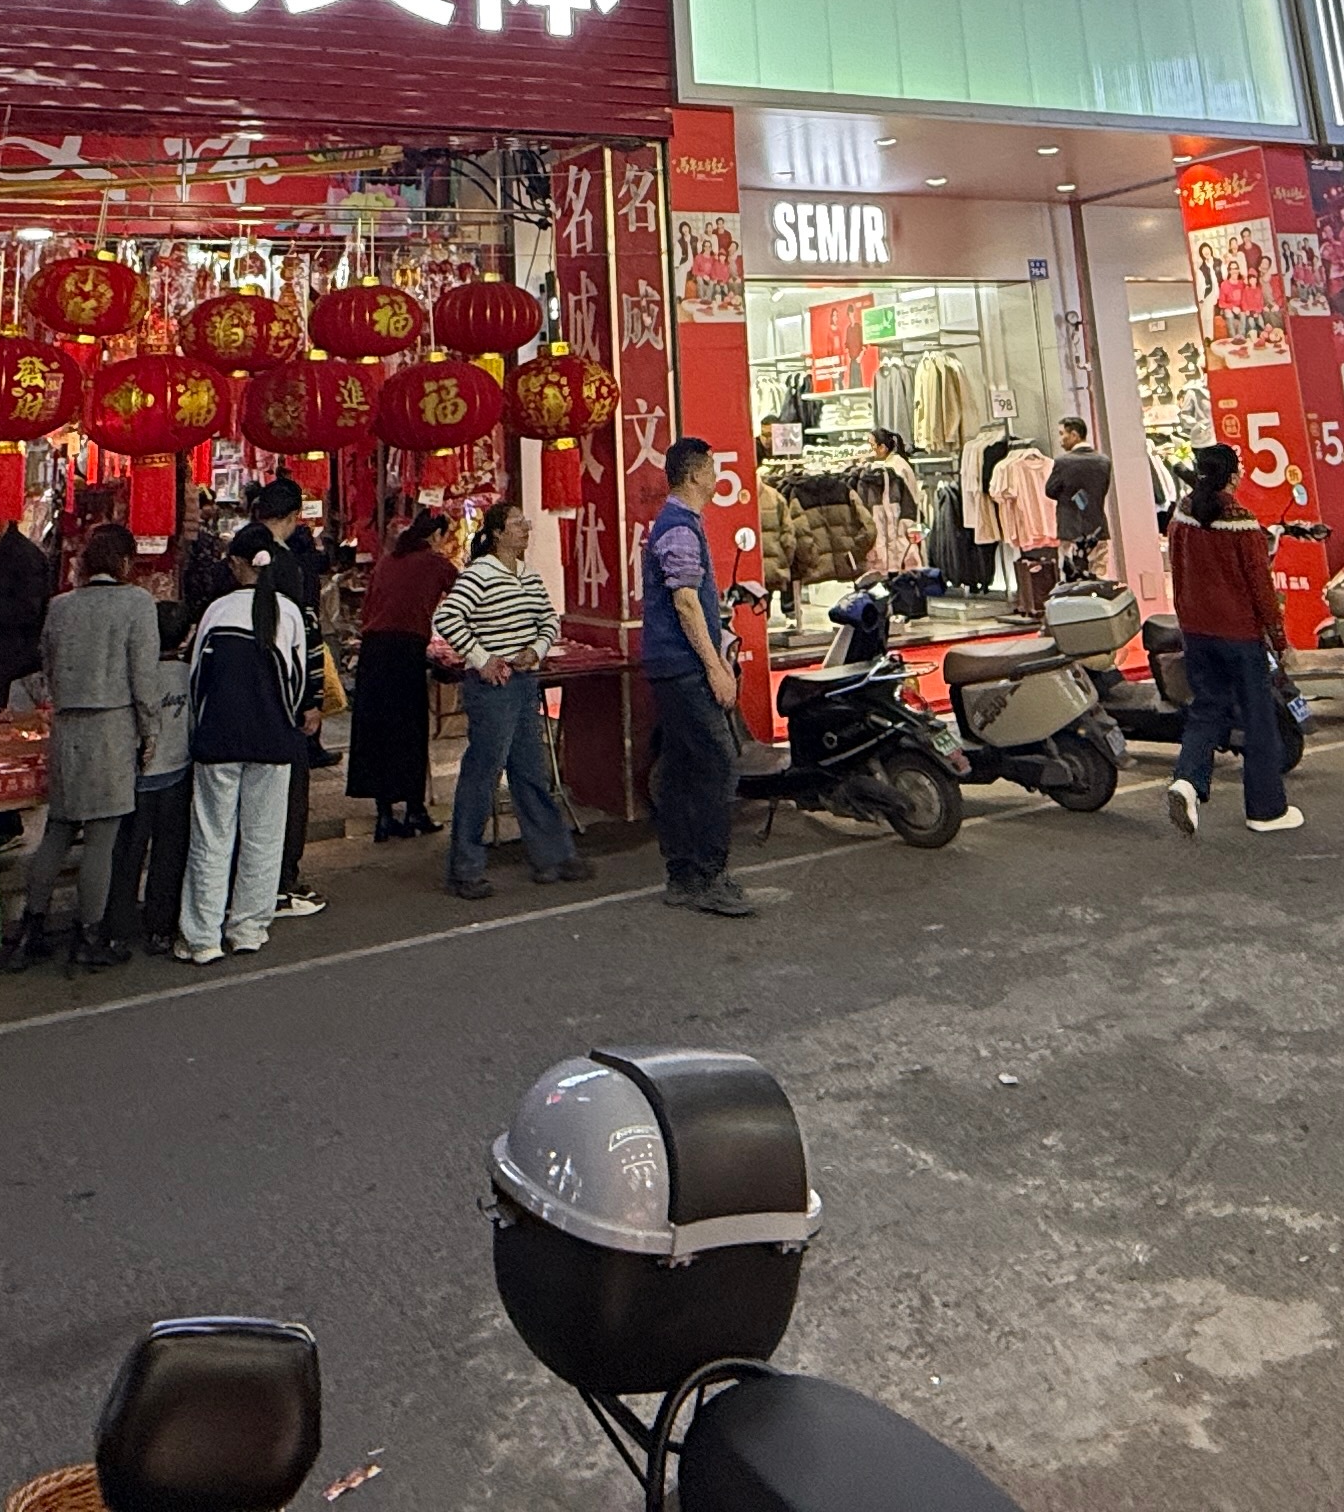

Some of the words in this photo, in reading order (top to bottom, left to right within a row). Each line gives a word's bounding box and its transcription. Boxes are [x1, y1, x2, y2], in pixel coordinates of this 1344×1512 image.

[772, 201, 891, 263] SEMIR
[373, 292, 414, 339] 福
[419, 376, 468, 426] 福
[1246, 412, 1290, 488] 5
[1322, 421, 1344, 466] 5
[711, 451, 743, 507] 5
